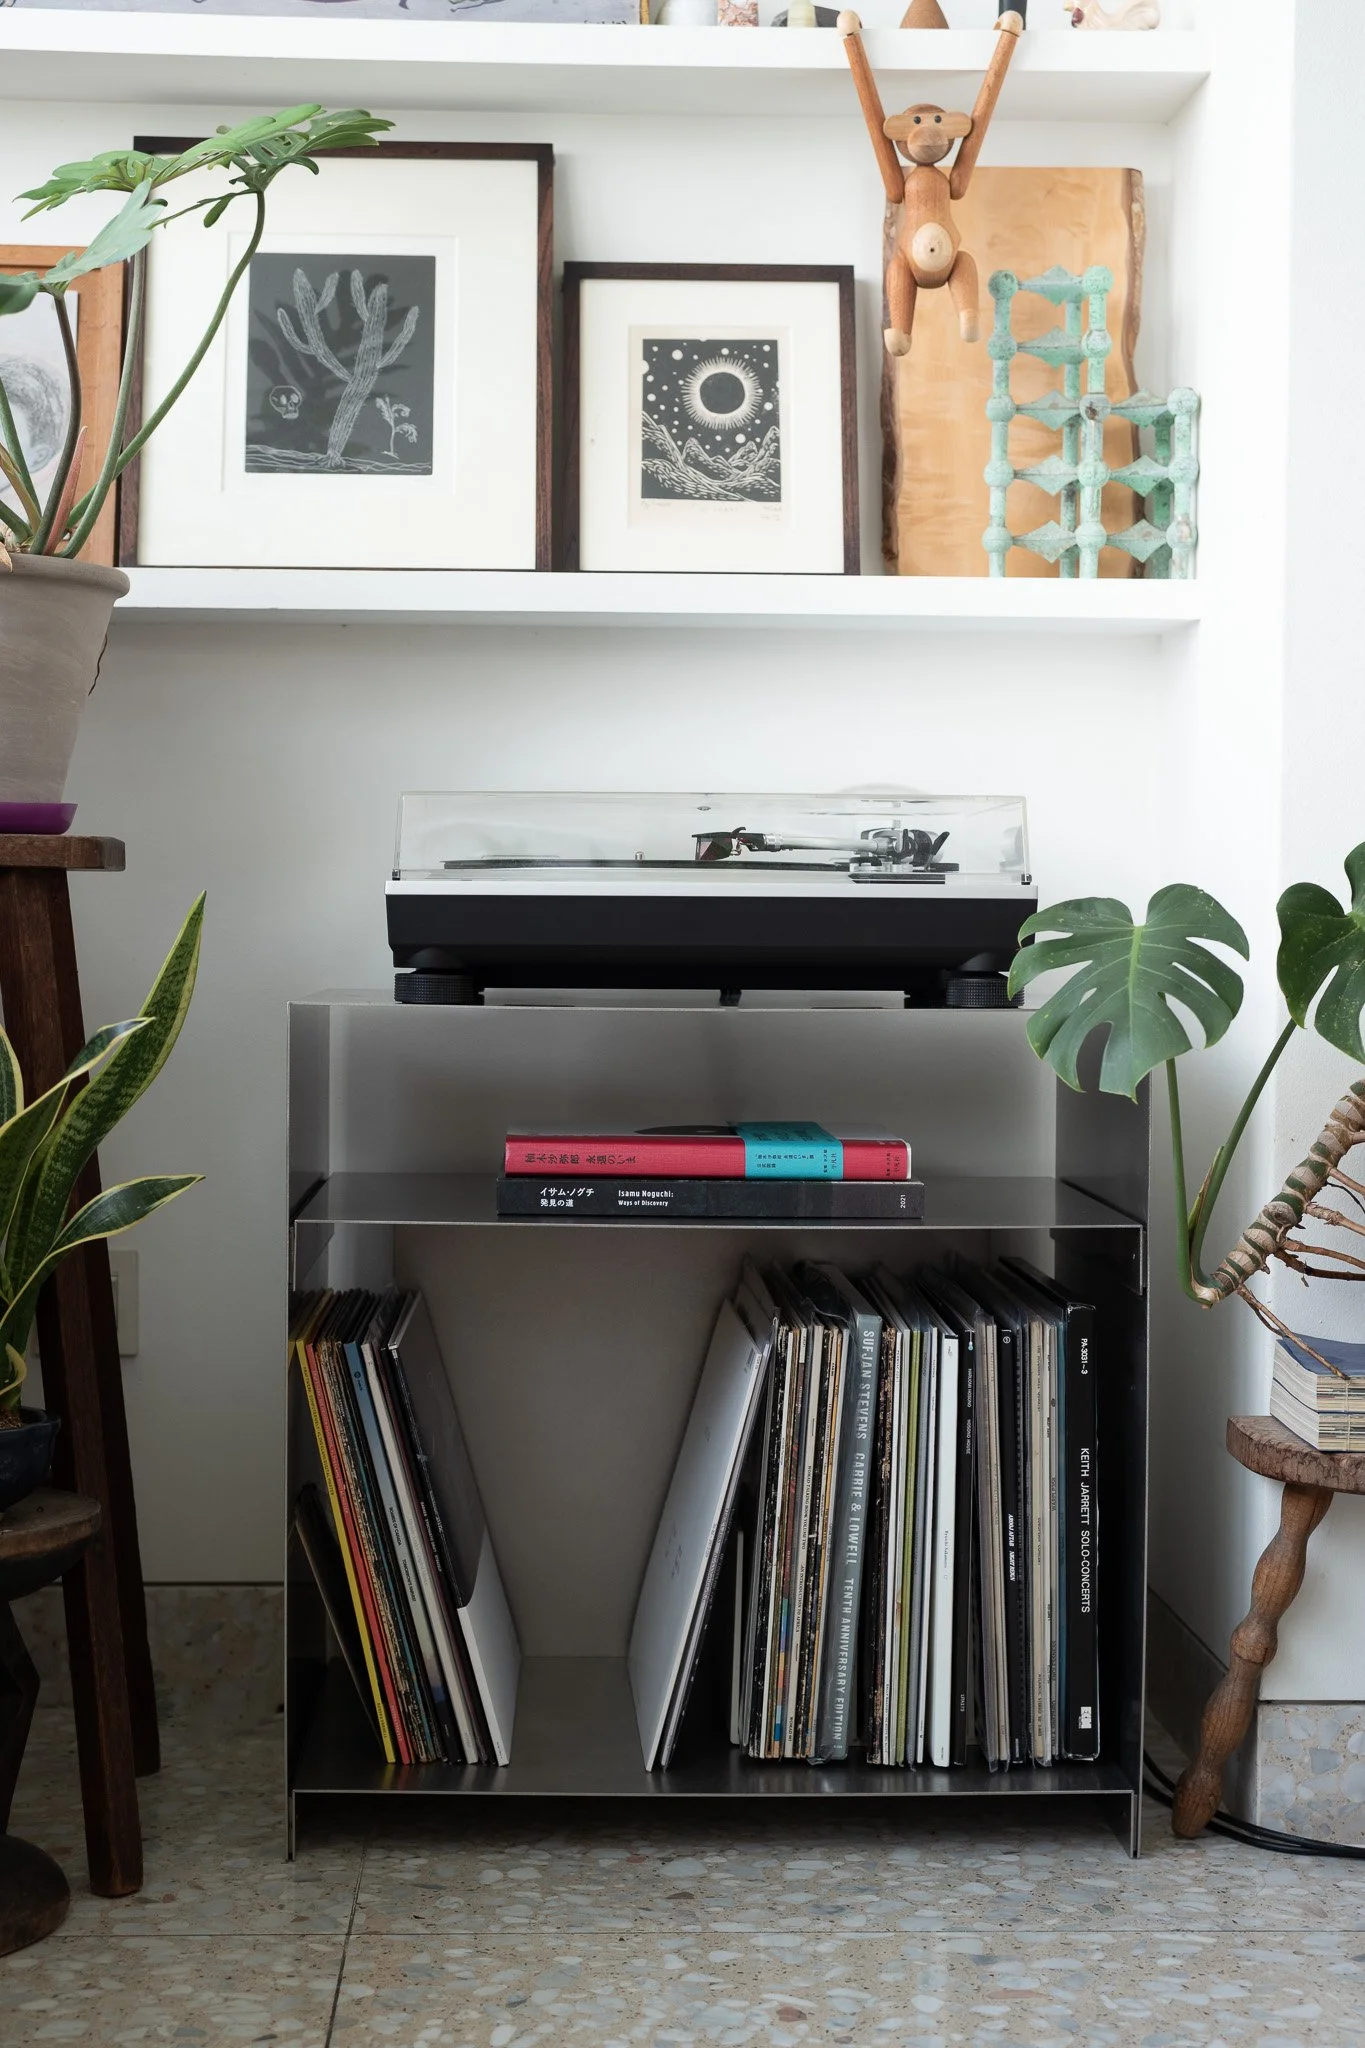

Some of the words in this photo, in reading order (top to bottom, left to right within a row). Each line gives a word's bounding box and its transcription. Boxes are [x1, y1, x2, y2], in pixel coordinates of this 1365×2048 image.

[586, 1155, 636, 1165] 永遠のいま
[540, 1187, 595, 1197] イサム・ノグチ
[540, 1199, 574, 1207] 発見の道
[618, 1189, 640, 1198] Isamu
[642, 1189, 674, 1199] Noguchi:
[641, 1199, 669, 1207] Discovery
[861, 1330, 875, 1379] SUFJAN
[857, 1383, 870, 1440] STEVENS
[851, 1452, 865, 1498] CARRIE
[1080, 1447, 1090, 1477] KEITH
[851, 1503, 862, 1512] &
[1080, 1481, 1090, 1525] JARRETT
[846, 1517, 860, 1565] LOWELL
[1081, 1530, 1091, 1613] SOLO-CONCERTS
[843, 1578, 853, 1614] TENTH
[837, 1615, 851, 1695] ANNIVERSARY
[833, 1696, 844, 1740] EDITION
